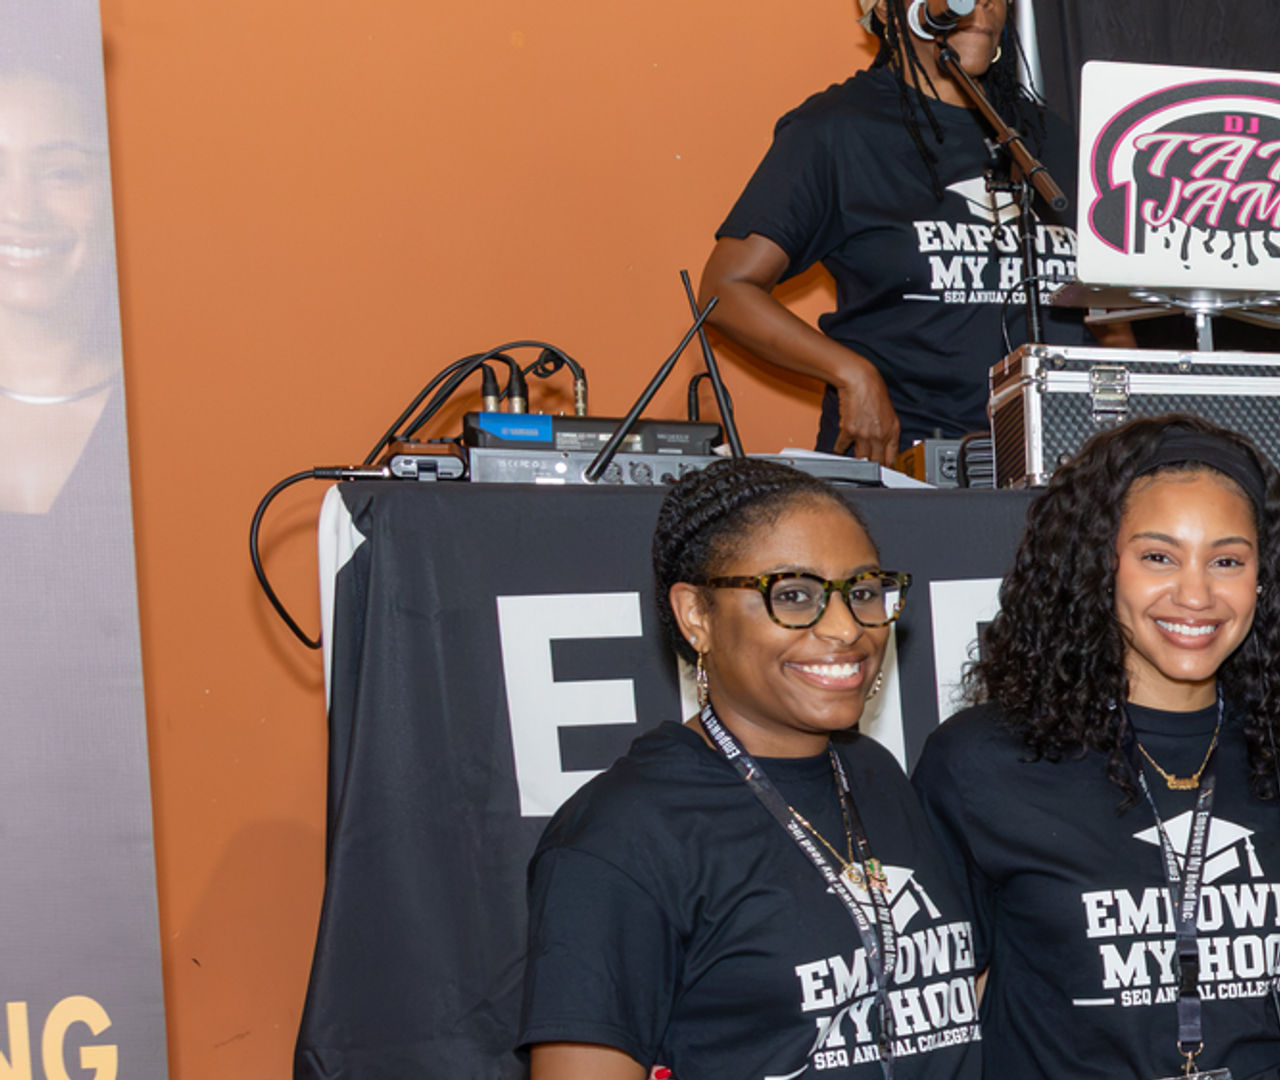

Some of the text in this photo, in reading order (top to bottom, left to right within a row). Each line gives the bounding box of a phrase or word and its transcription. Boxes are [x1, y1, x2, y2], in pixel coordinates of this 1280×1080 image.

[1224, 114, 1260, 134] DJ
[913, 221, 1078, 256] EMPOWE
[929, 255, 989, 290] MY
[795, 922, 975, 1012] EMOWE
[1100, 940, 1176, 989] MY
[1121, 989, 1152, 1007] SEQ
[1155, 984, 1216, 1005] ANAL
[814, 1049, 850, 1070] SEQ
[854, 1039, 917, 1063] ANAL
